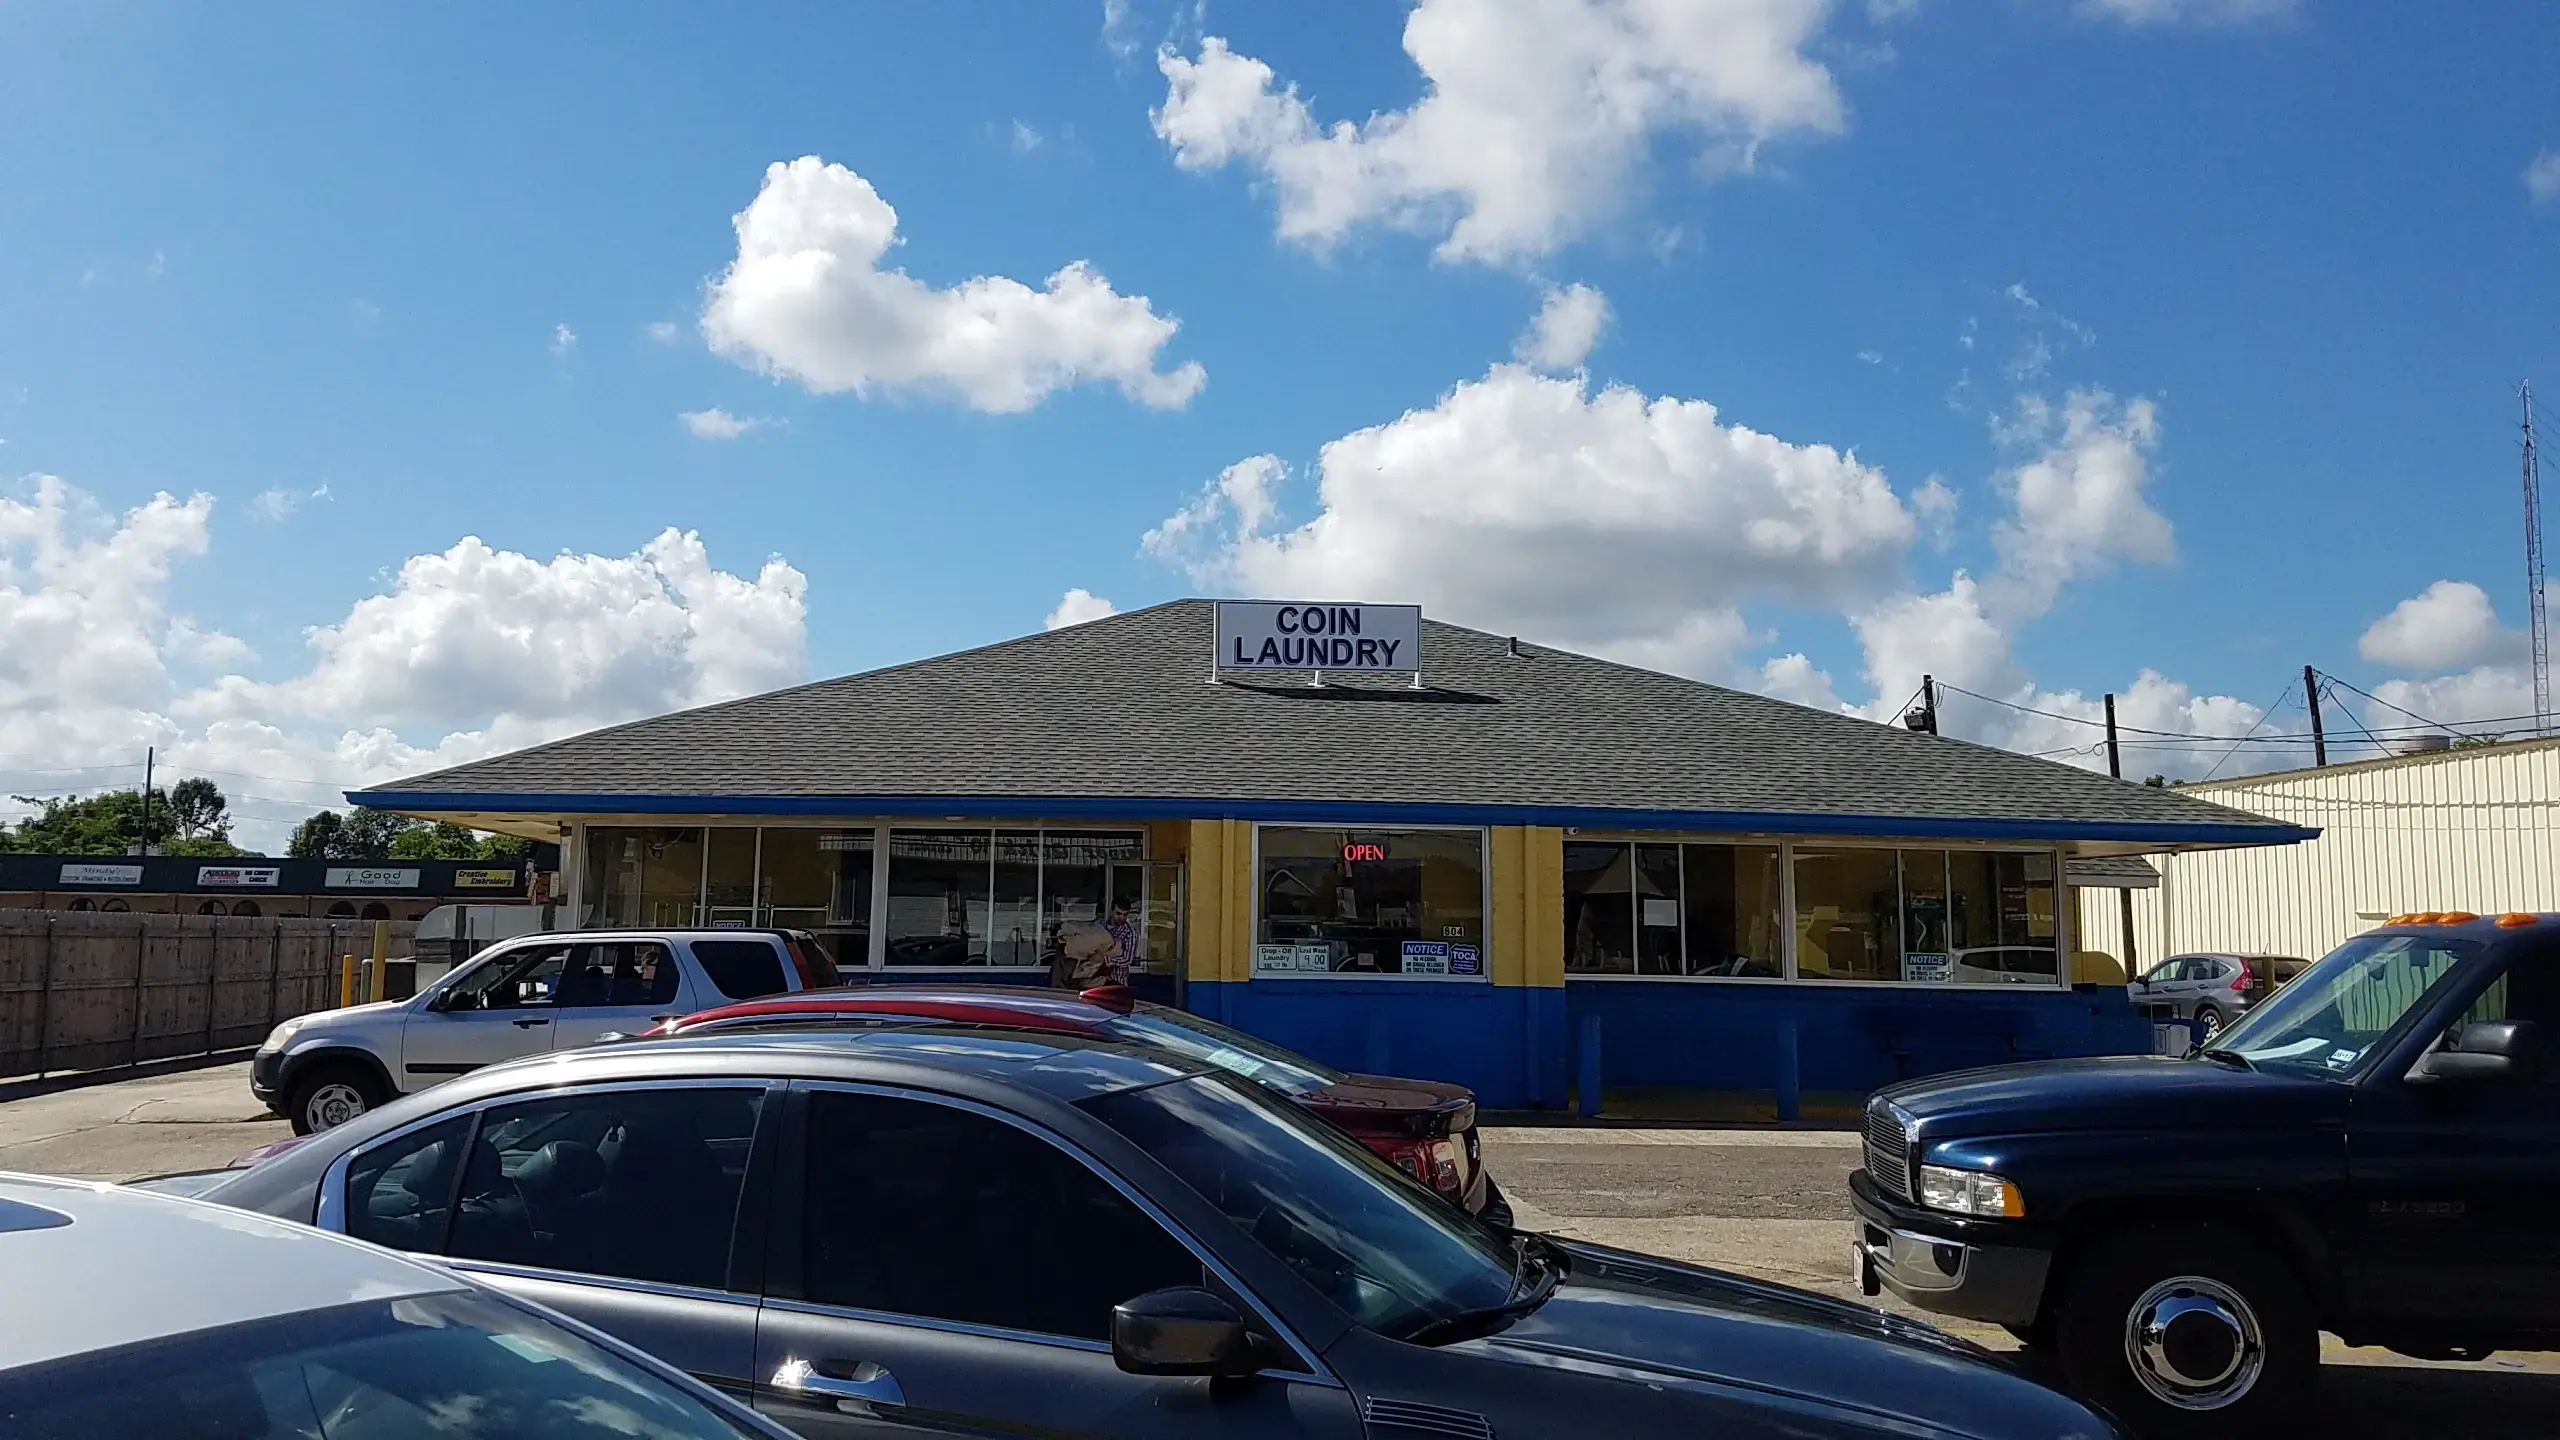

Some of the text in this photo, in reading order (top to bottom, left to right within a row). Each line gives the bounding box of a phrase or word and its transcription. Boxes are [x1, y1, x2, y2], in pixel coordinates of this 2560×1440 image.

[1276, 606, 1361, 636] COIN
[1233, 636, 1402, 668] LAUNDRY
[1344, 844, 1384, 861] OPEN
[361, 870, 402, 879] Good
[1444, 926, 1463, 936] 804
[1406, 944, 1445, 955] NOTICE
[1264, 954, 1289, 962] Laundry
[1452, 951, 1477, 961] TOCA
[1910, 955, 1945, 965] NOTICE
